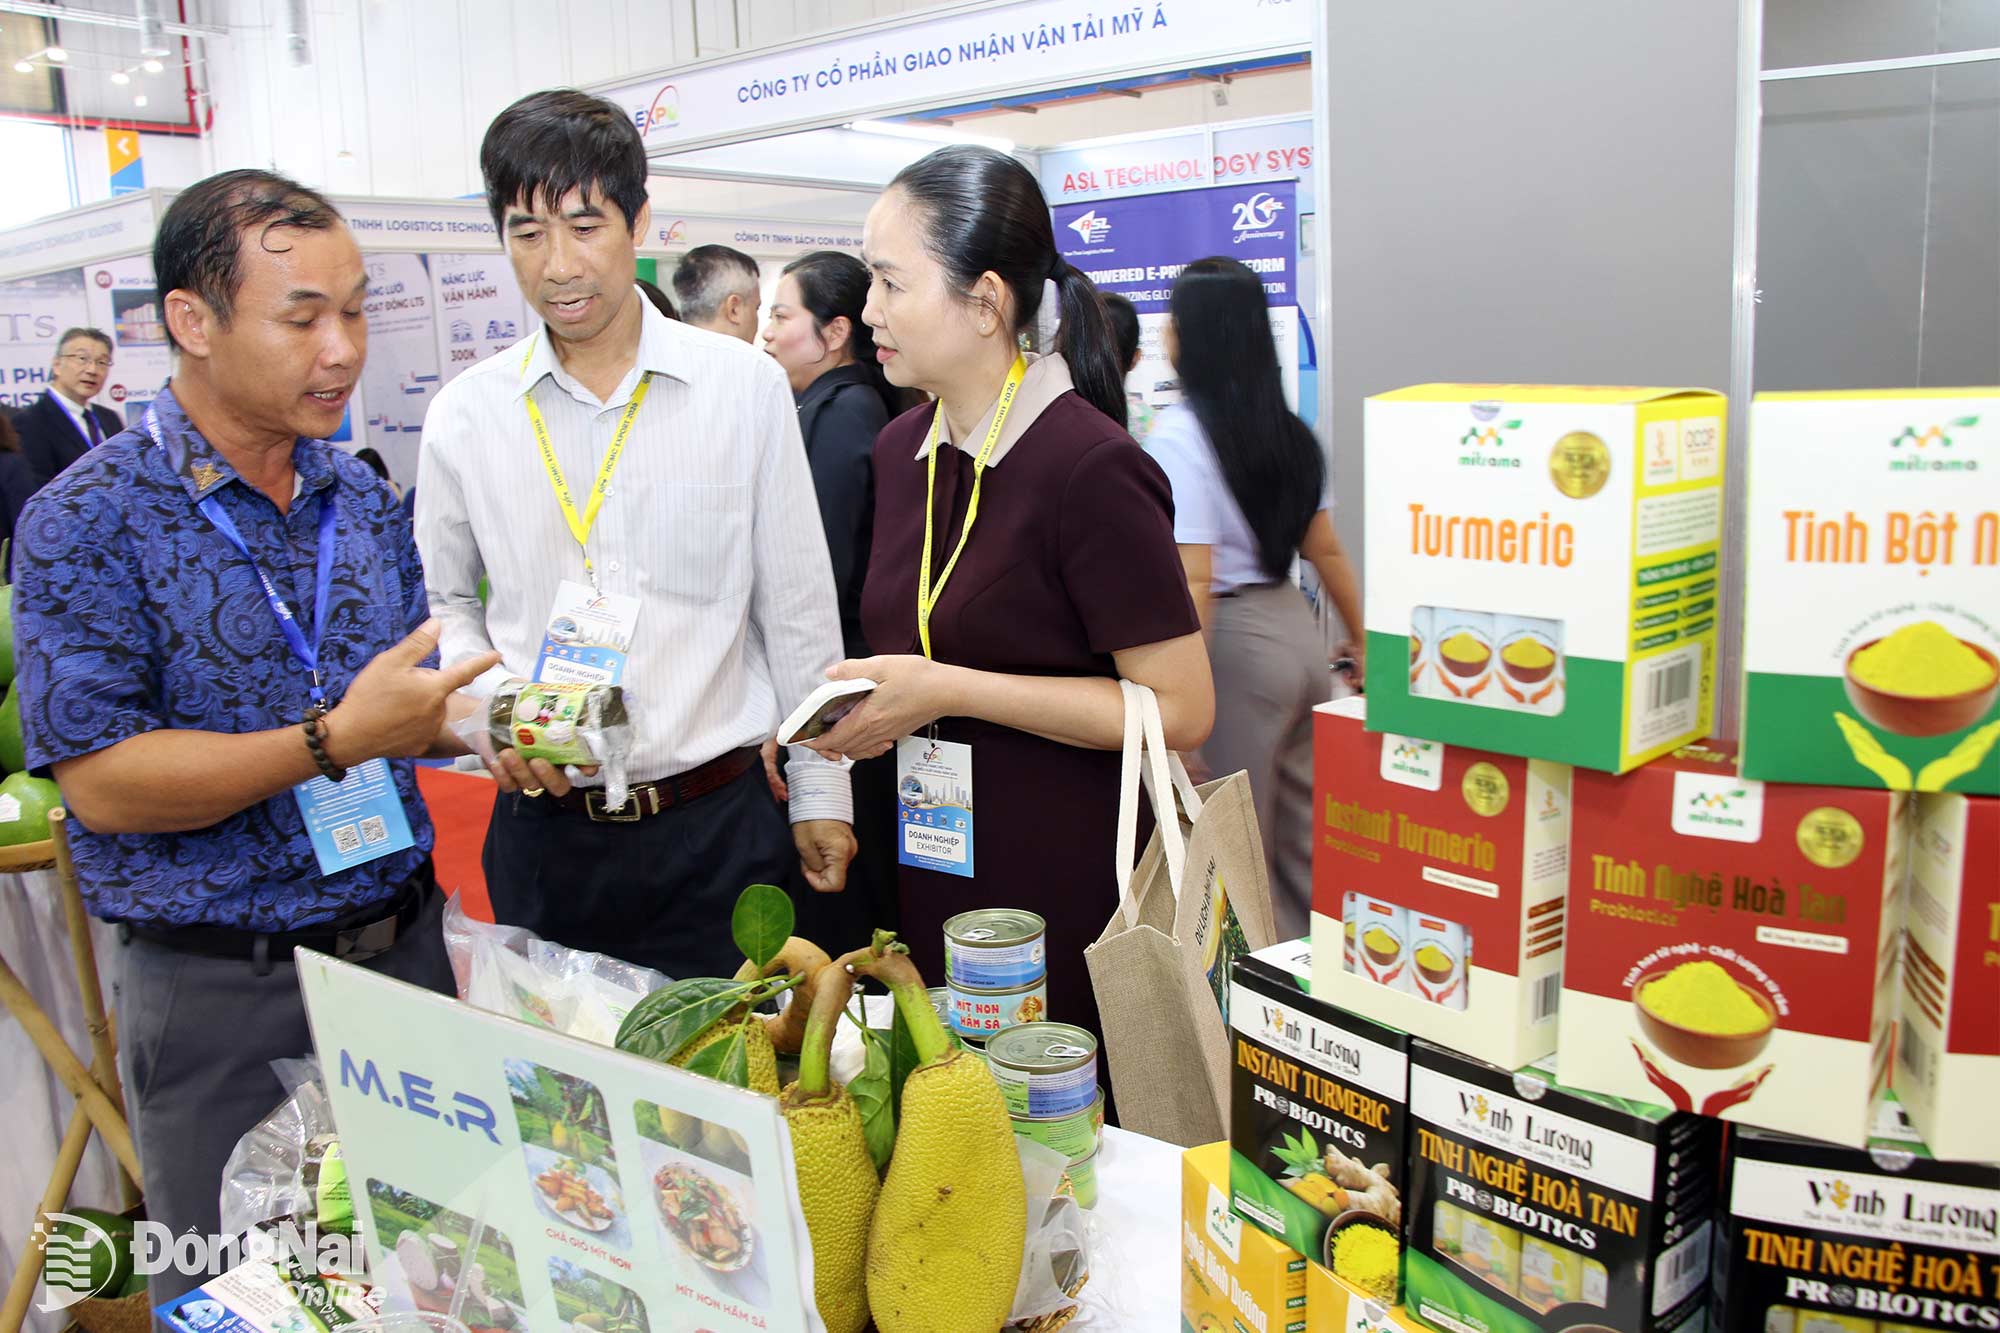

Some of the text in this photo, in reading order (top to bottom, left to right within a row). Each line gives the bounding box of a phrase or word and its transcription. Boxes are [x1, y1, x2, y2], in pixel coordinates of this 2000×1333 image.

[737, 2, 1167, 103] CÔNG TY CỔ PHẦN GIAO NHẬN VẬN TẢI MỸ Á
[1063, 172, 1099, 193] ASL
[1267, 146, 1314, 169] SYS
[352, 219, 496, 234] TNHH LOGISTICS TECHNOL
[735, 231, 760, 242] CÔNG
[762, 233, 770, 243] TY
[772, 234, 793, 244] TNHH
[451, 347, 477, 362] 300K
[976, 381, 1017, 469] HCMC EXPORT 2026
[1408, 503, 1575, 568] Turmeric
[1782, 511, 1869, 564] Tinh
[1885, 510, 1958, 577] Bột
[908, 831, 960, 846] DOANH NGHIỆP
[916, 841, 952, 855] EXHIBITOR
[1325, 792, 1392, 844] Instant
[1397, 813, 1496, 872] Turmeric
[1589, 898, 1679, 927] Probiotics
[1592, 853, 1647, 898] Tinh
[1654, 864, 1723, 915] Nghệ
[1798, 881, 1847, 924] Tan
[975, 1003, 1000, 1015] NON
[1310, 1026, 1361, 1076] Lương
[340, 1048, 503, 1146] M.E.R
[1237, 1039, 1300, 1093] INSTANT
[1302, 1070, 1390, 1133] TURMERIC
[1253, 1083, 1367, 1149] PROBIOTICS
[1525, 1114, 1593, 1168] Lương
[1418, 1127, 1465, 1173] TINH
[1468, 1149, 1528, 1204] NGHỆ
[1531, 1172, 1584, 1219] HOÀ
[1587, 1192, 1639, 1238] TAN
[1446, 1177, 1598, 1250] PROBIOTICS
[1904, 1192, 1998, 1239] Lương
[545, 1227, 568, 1245] CHẢ
[590, 1243, 608, 1261] MÍT
[609, 1254, 633, 1272] NON
[1743, 1228, 1816, 1273] TINH
[1818, 1241, 1907, 1293] NGHỆ
[1910, 1254, 1983, 1298] HOÀ
[676, 1283, 694, 1299] MÍT
[696, 1291, 721, 1311] NON
